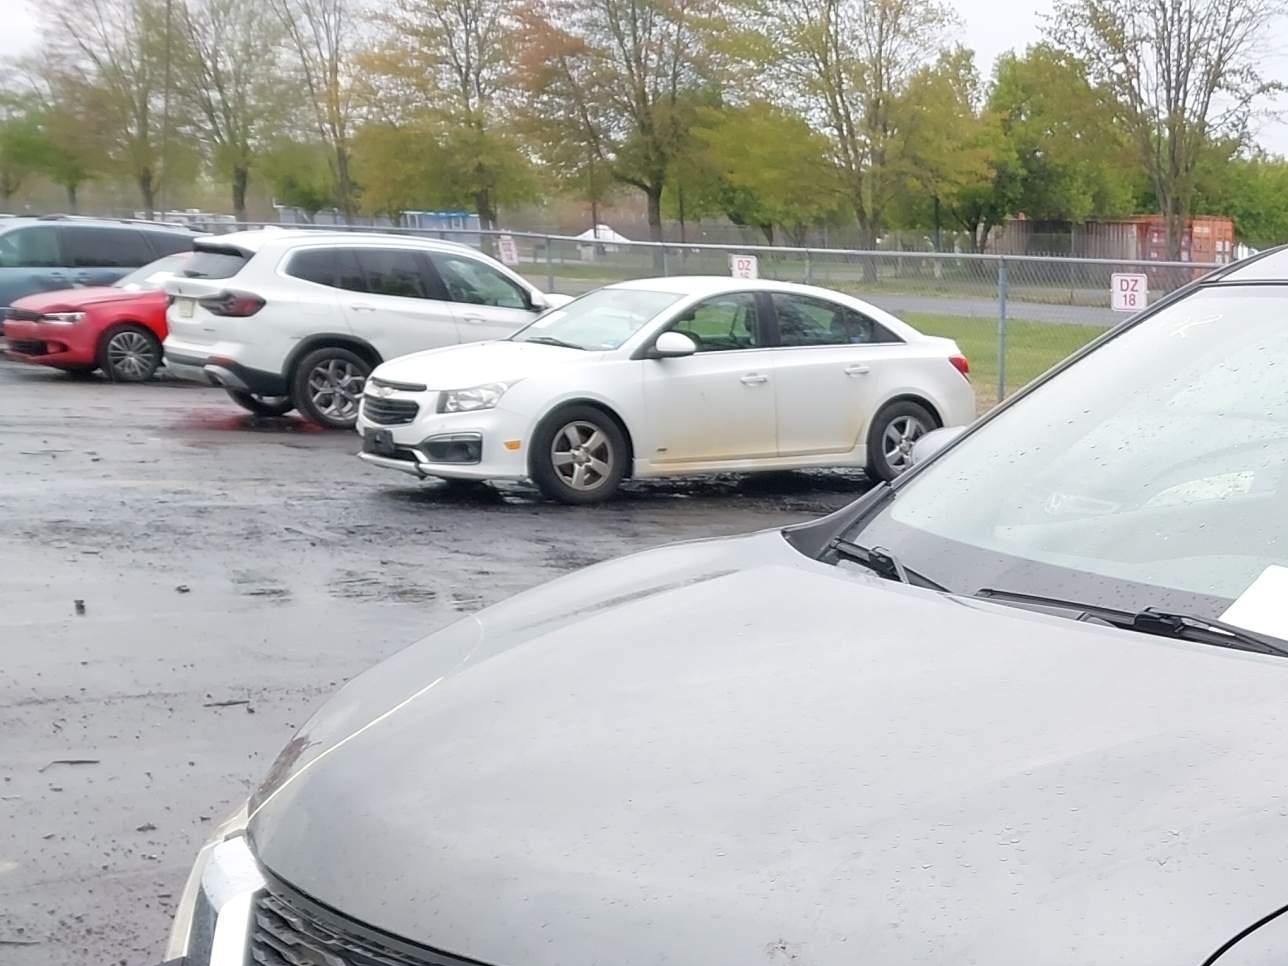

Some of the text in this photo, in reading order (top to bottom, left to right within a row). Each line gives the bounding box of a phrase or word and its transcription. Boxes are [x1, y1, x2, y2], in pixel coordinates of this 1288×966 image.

[737, 259, 751, 271] DZ
[1120, 279, 1139, 292] DZ
[1122, 293, 1136, 306] 18
